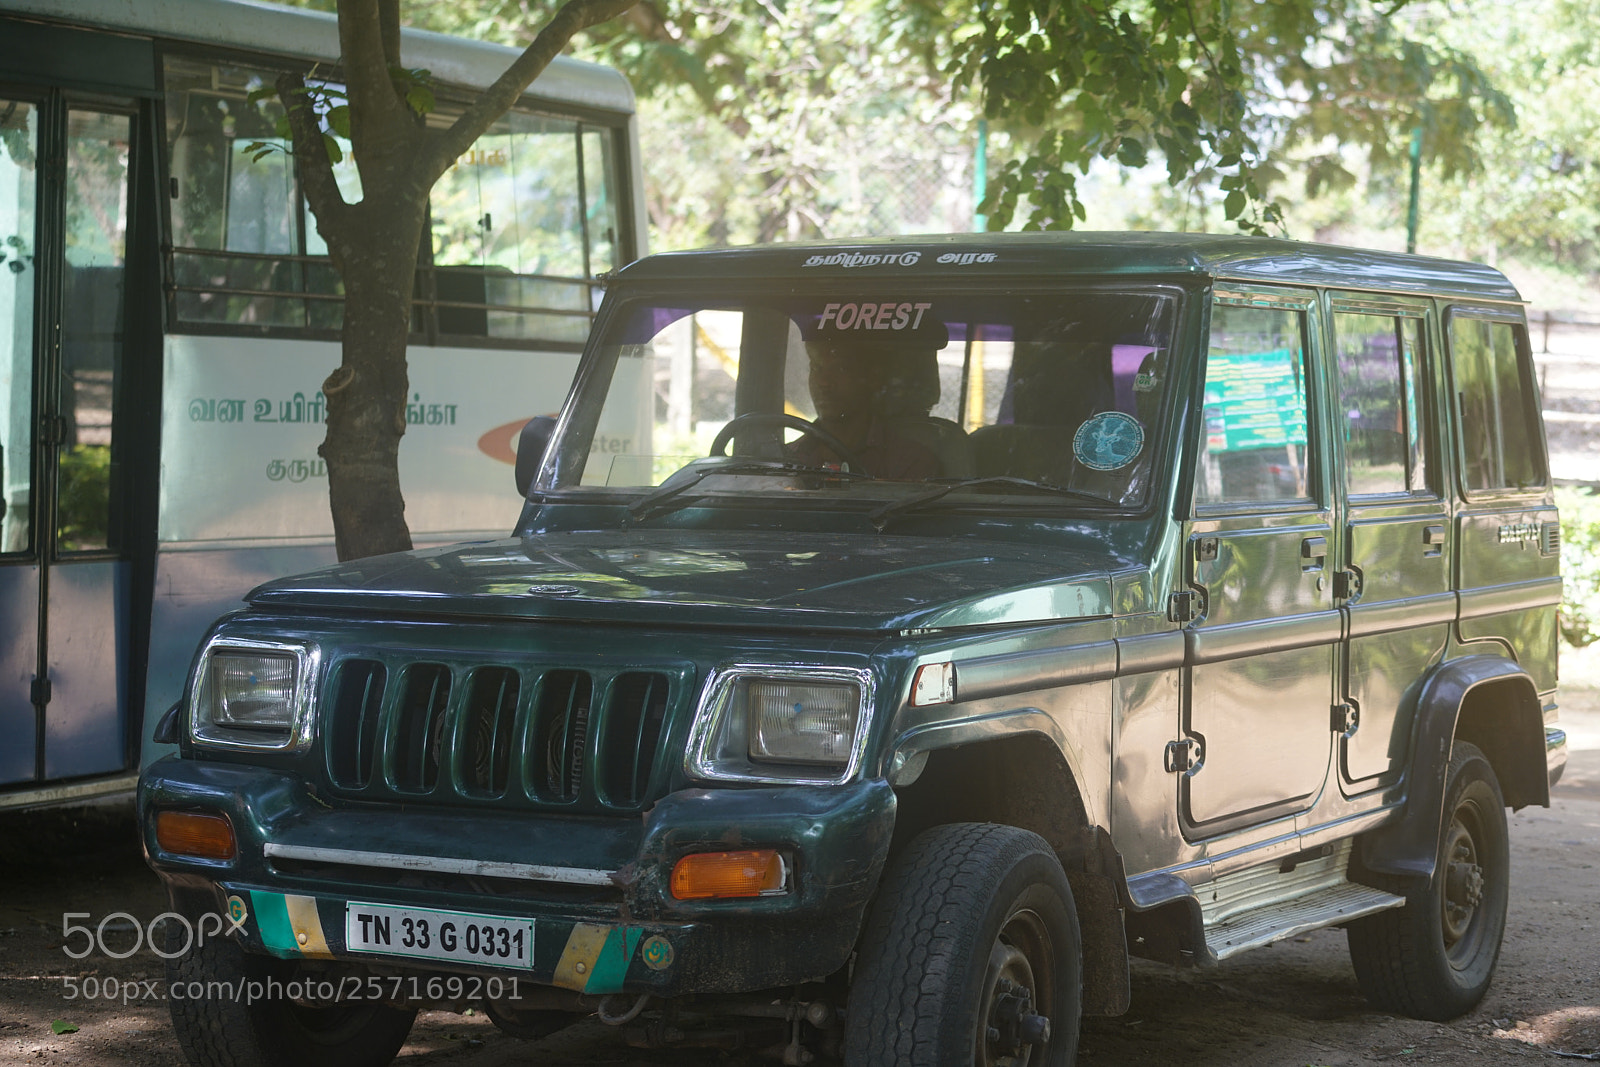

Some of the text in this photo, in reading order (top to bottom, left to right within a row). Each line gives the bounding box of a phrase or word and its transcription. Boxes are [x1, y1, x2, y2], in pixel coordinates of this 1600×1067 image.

[802, 252, 998, 268] தமிழ்நாடு அரசு
[817, 303, 932, 330] FOREST
[189, 391, 458, 426] வன உயிரி ங்கா
[266, 458, 328, 483] குரும
[357, 914, 524, 959] TN 33 G 0331
